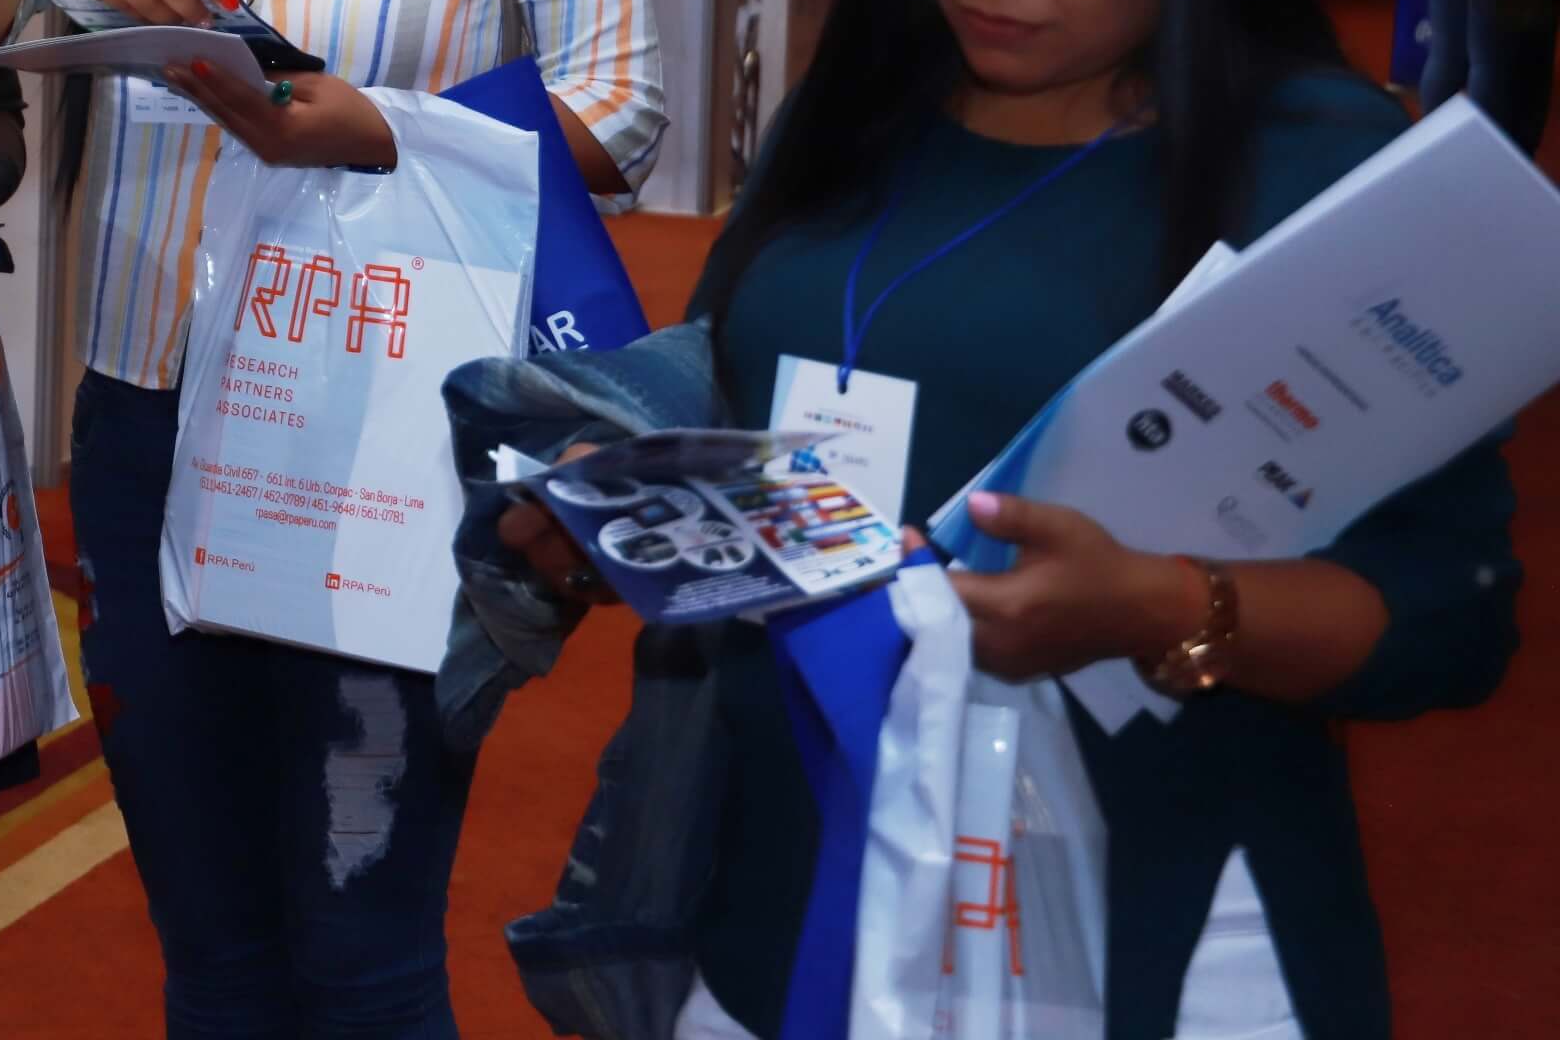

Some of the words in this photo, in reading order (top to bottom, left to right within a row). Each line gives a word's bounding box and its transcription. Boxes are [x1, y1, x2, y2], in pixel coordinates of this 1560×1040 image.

[234, 243, 411, 359] RPA
[219, 375, 294, 402] PARTNERS
[216, 399, 305, 428] ASSOCIATES
[323, 481, 353, 498] Corpac
[359, 487, 375, 502] San
[404, 495, 425, 509] Lima
[207, 553, 229, 568] RPA
[342, 579, 365, 592] RPA
